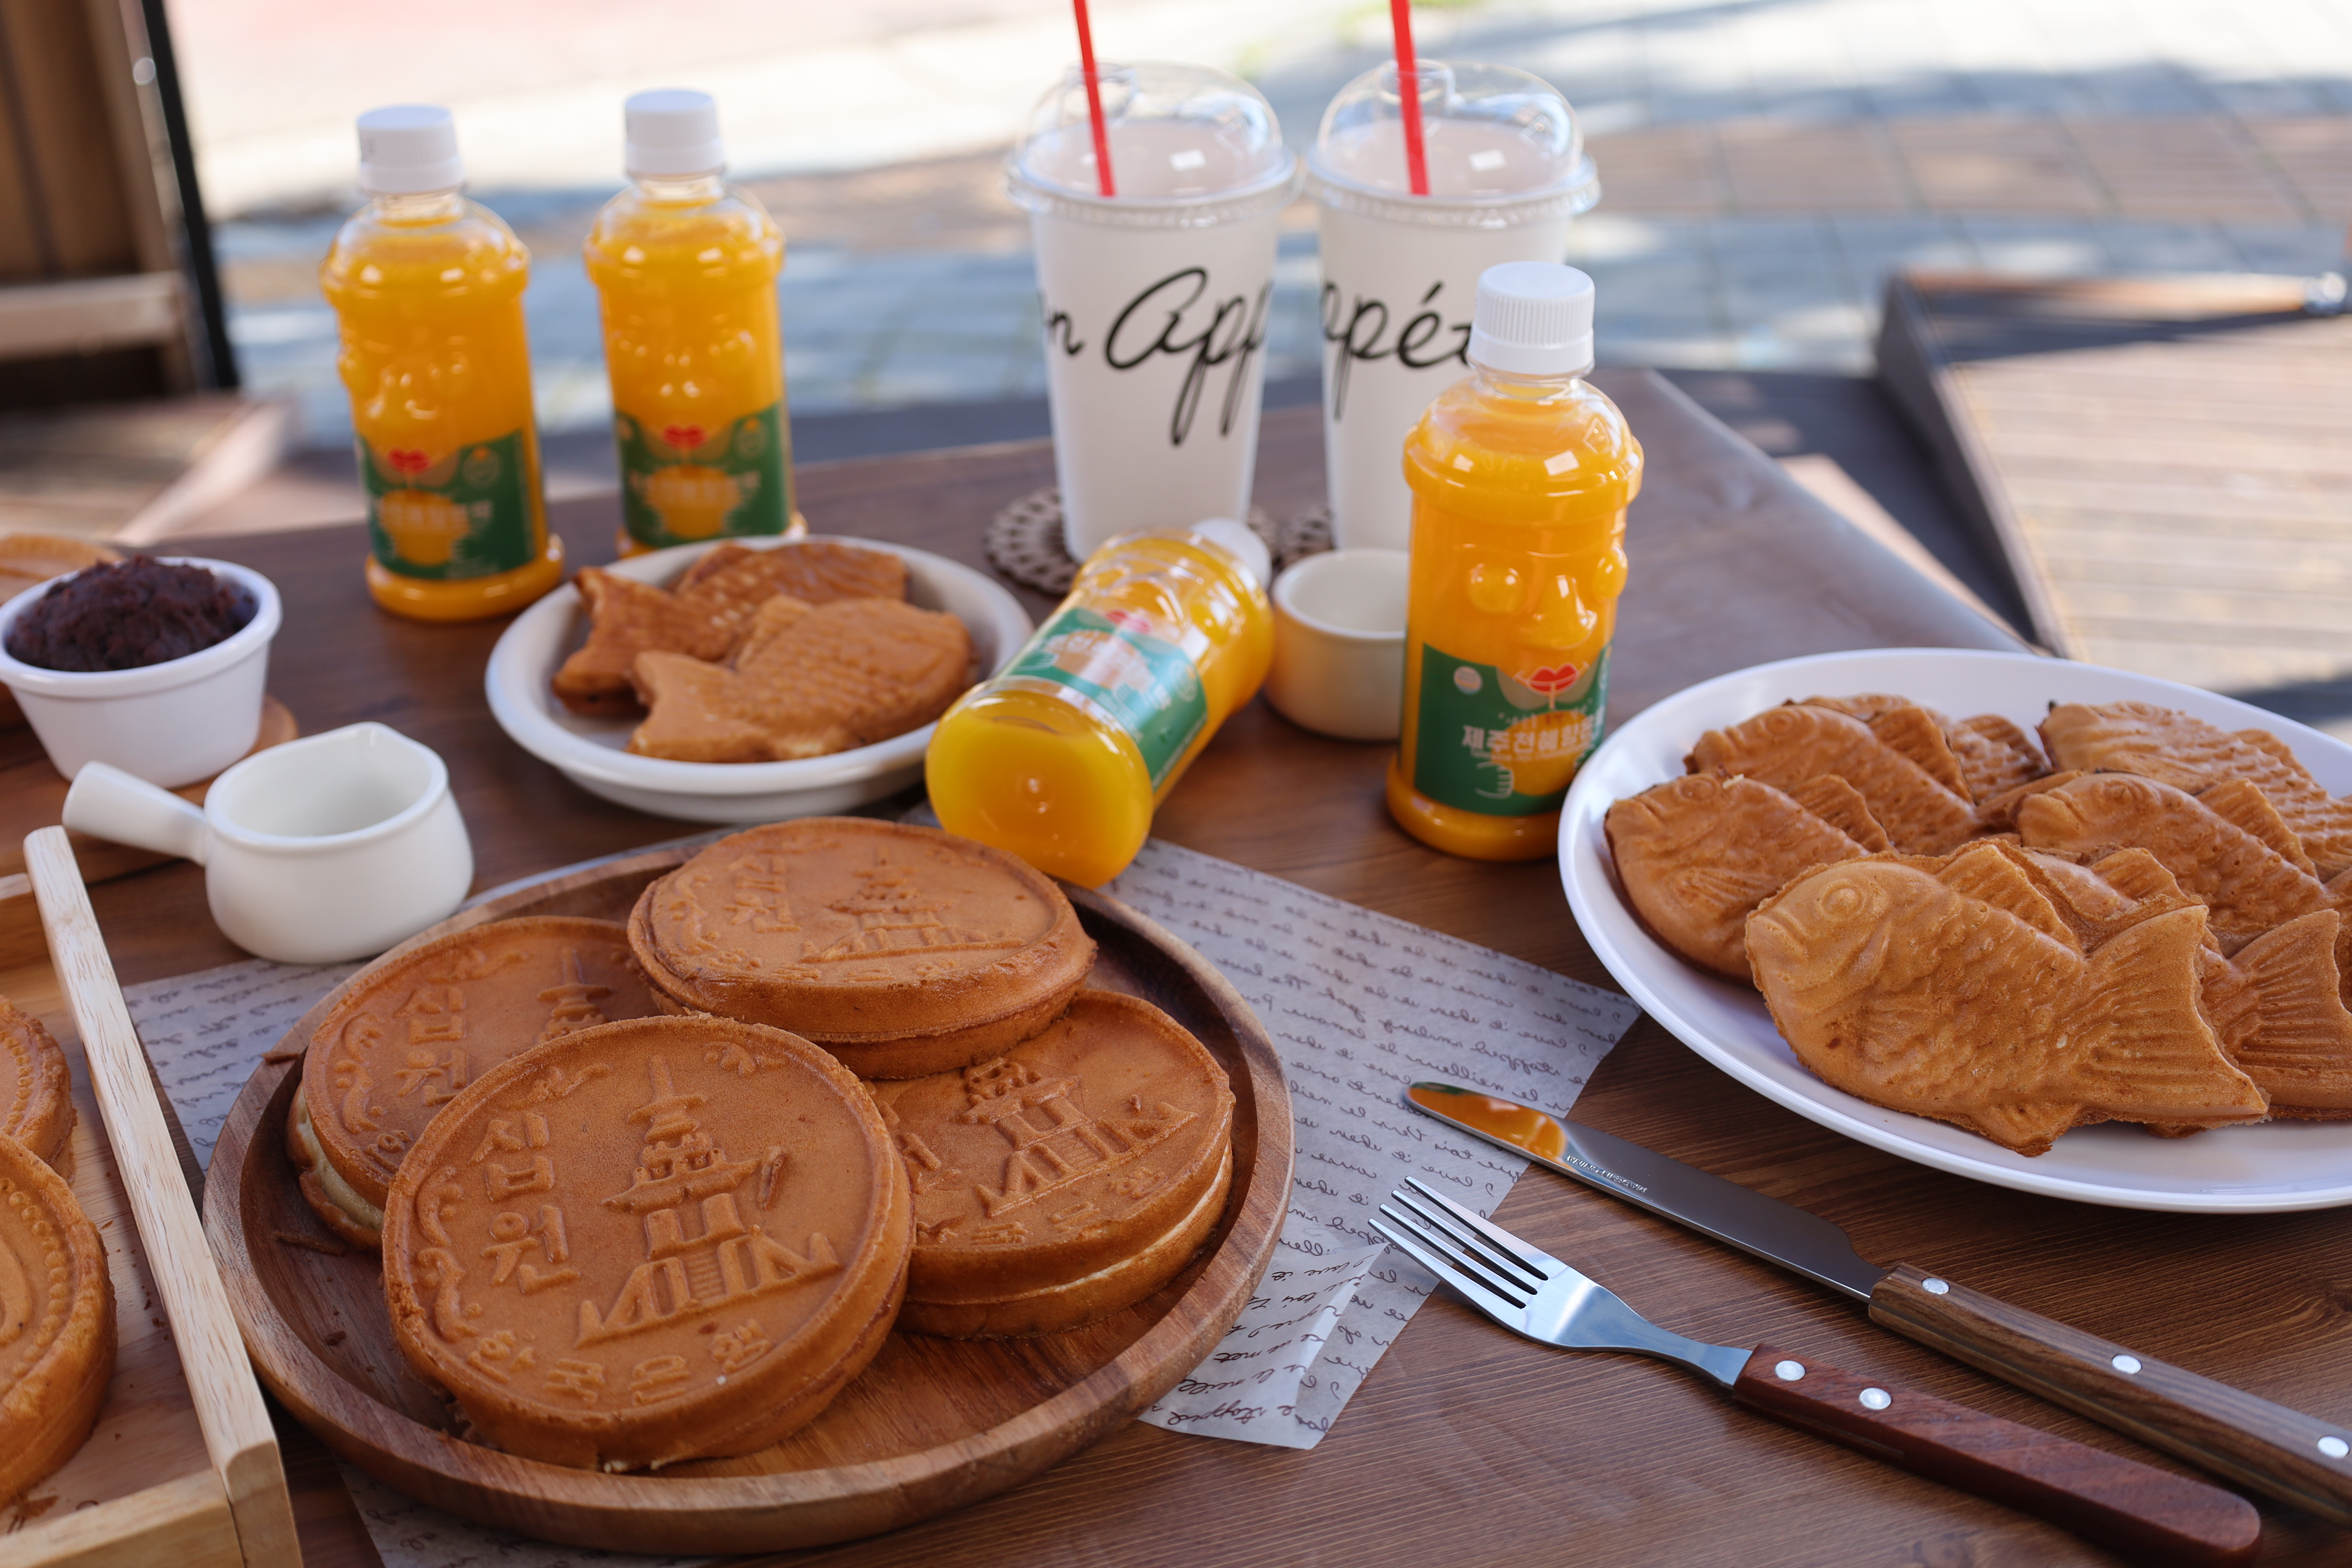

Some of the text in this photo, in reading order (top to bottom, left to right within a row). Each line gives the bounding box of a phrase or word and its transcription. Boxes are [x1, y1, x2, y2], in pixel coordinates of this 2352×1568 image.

[469, 1112, 581, 1295] 십원
[1303, 1262, 1350, 1276] love
[1271, 1271, 1293, 1281] it
[1213, 1351, 1260, 1363] met
